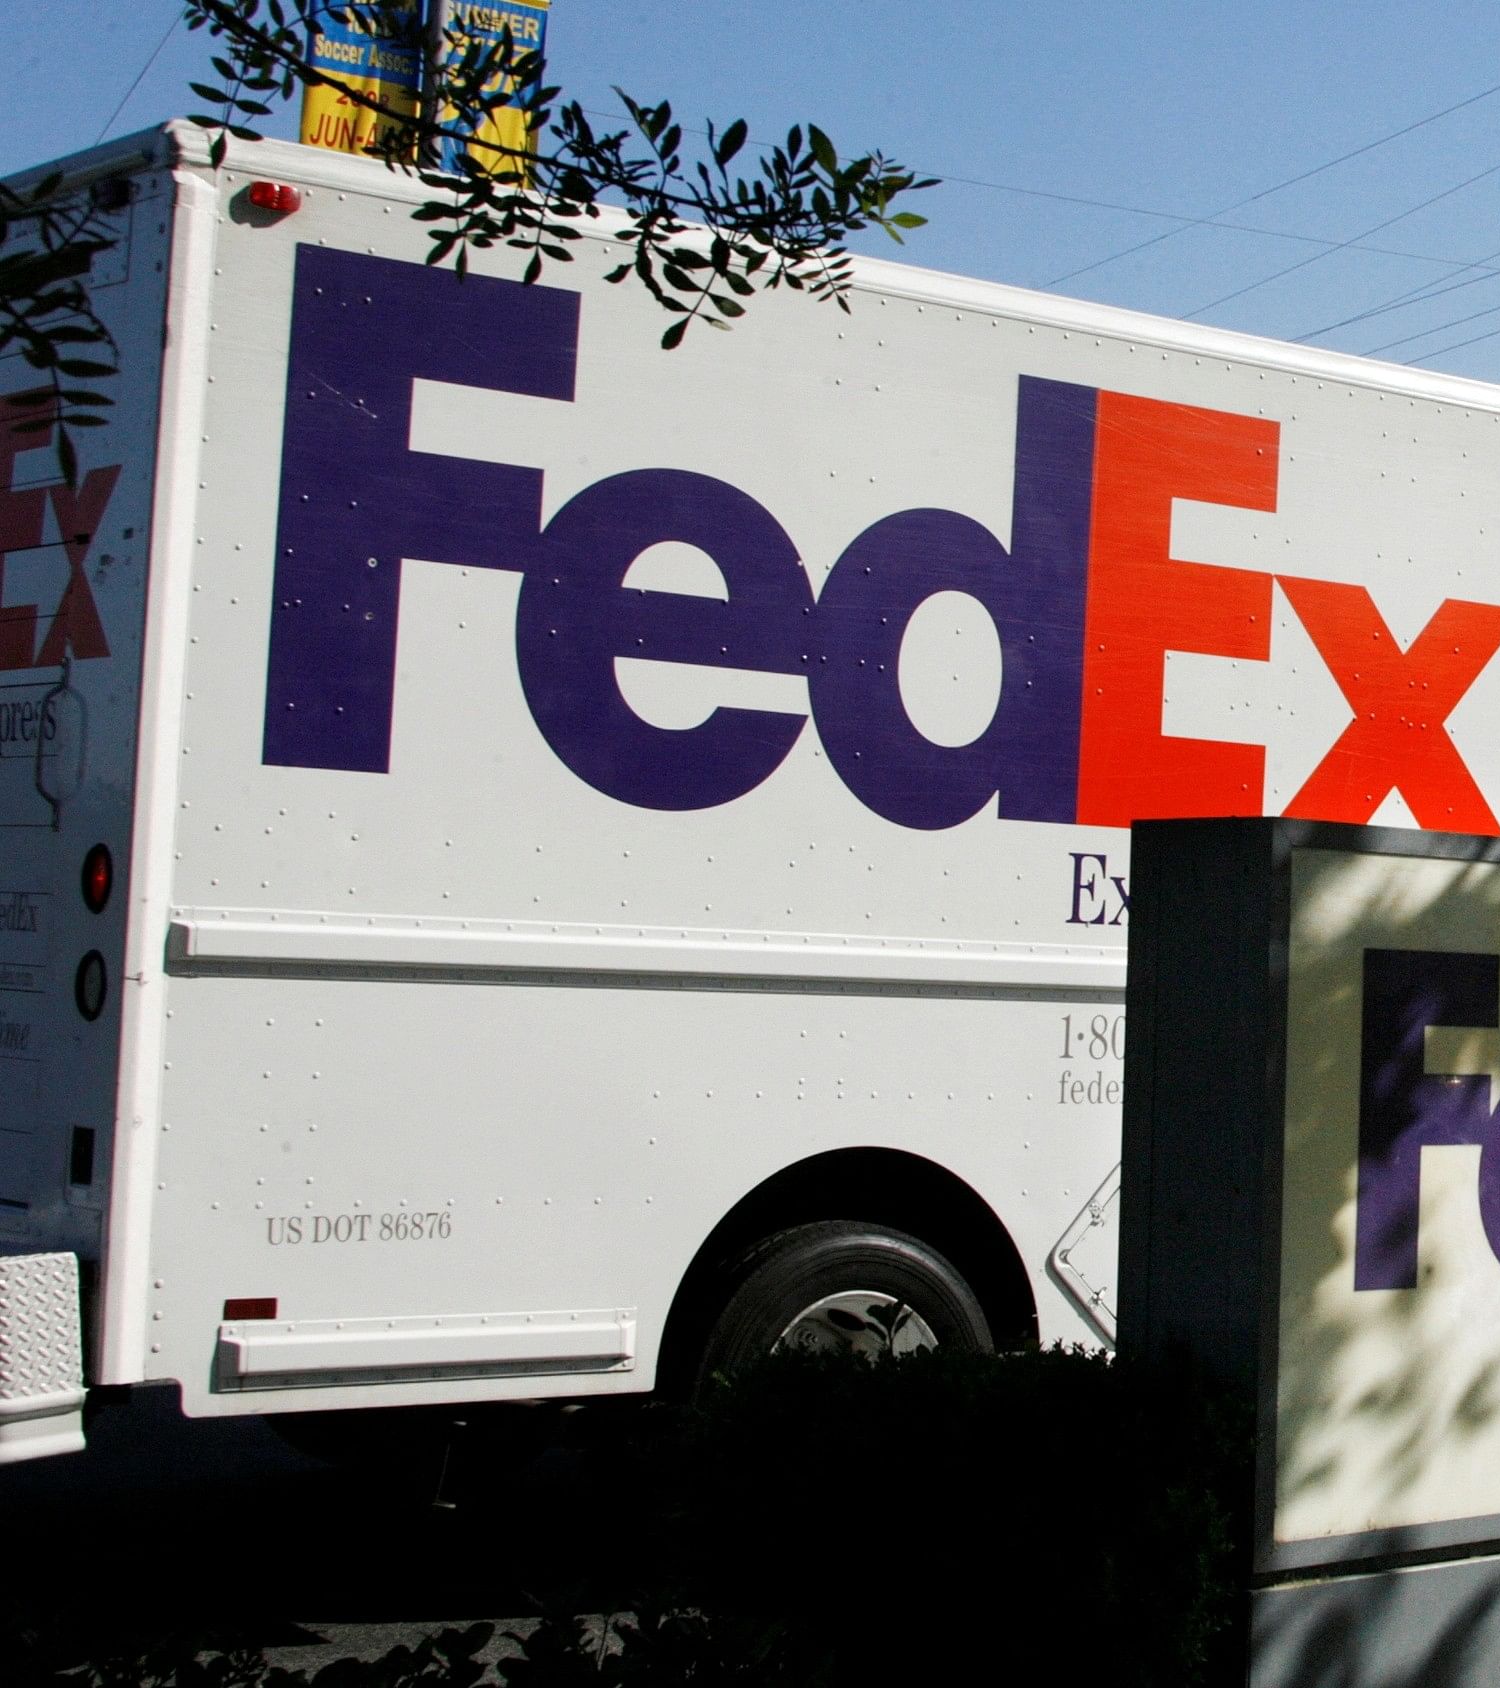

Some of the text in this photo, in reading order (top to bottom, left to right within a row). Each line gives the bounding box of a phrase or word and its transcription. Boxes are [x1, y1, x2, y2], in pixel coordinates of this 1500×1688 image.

[314, 33, 364, 65] Soccer
[266, 1211, 452, 1246] US DOT 86876
